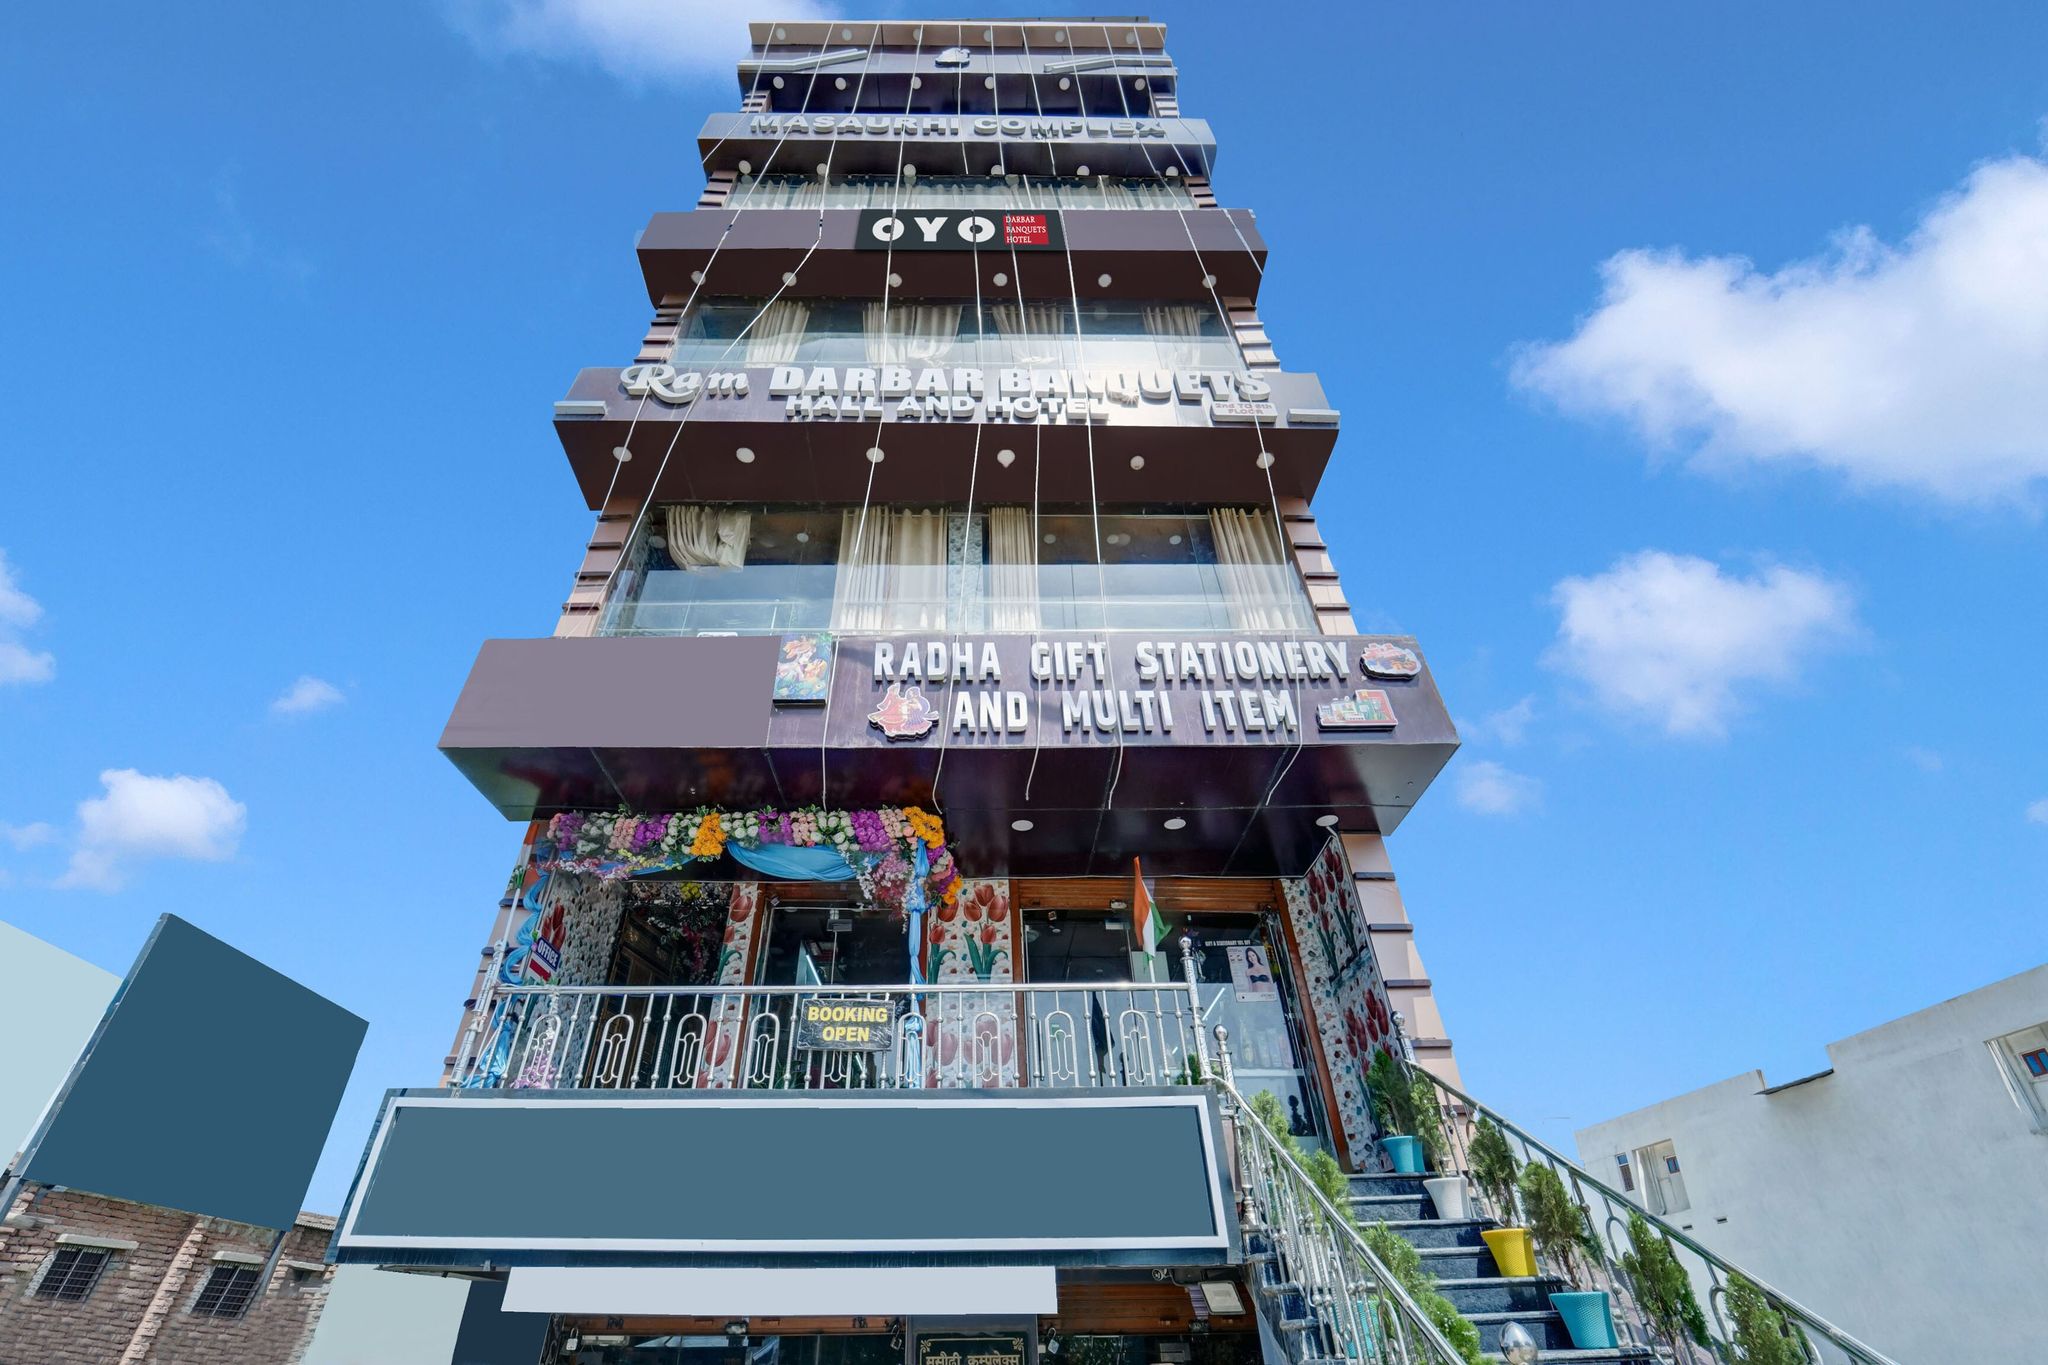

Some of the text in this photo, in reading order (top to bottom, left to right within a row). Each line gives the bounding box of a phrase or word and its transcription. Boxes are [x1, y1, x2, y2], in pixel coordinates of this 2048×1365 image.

[751, 115, 1165, 138] MASAURHI COMPLEX
[872, 216, 996, 243] OYO
[1005, 215, 1036, 223] DARBAR
[1006, 225, 1047, 234] BANQUETS
[1006, 236, 1032, 244] HOTEL
[620, 364, 1271, 404] Ram DARBAR BANQUETS
[786, 396, 1109, 421] HALL AND HOTEL
[874, 641, 1350, 681] RADHA GIFT STATIONERY
[952, 690, 1297, 733] AND MULTI ITEM
[537, 939, 559, 968] OFFICE
[807, 1006, 889, 1022] BOOKING
[822, 1026, 870, 1042] OPEN
